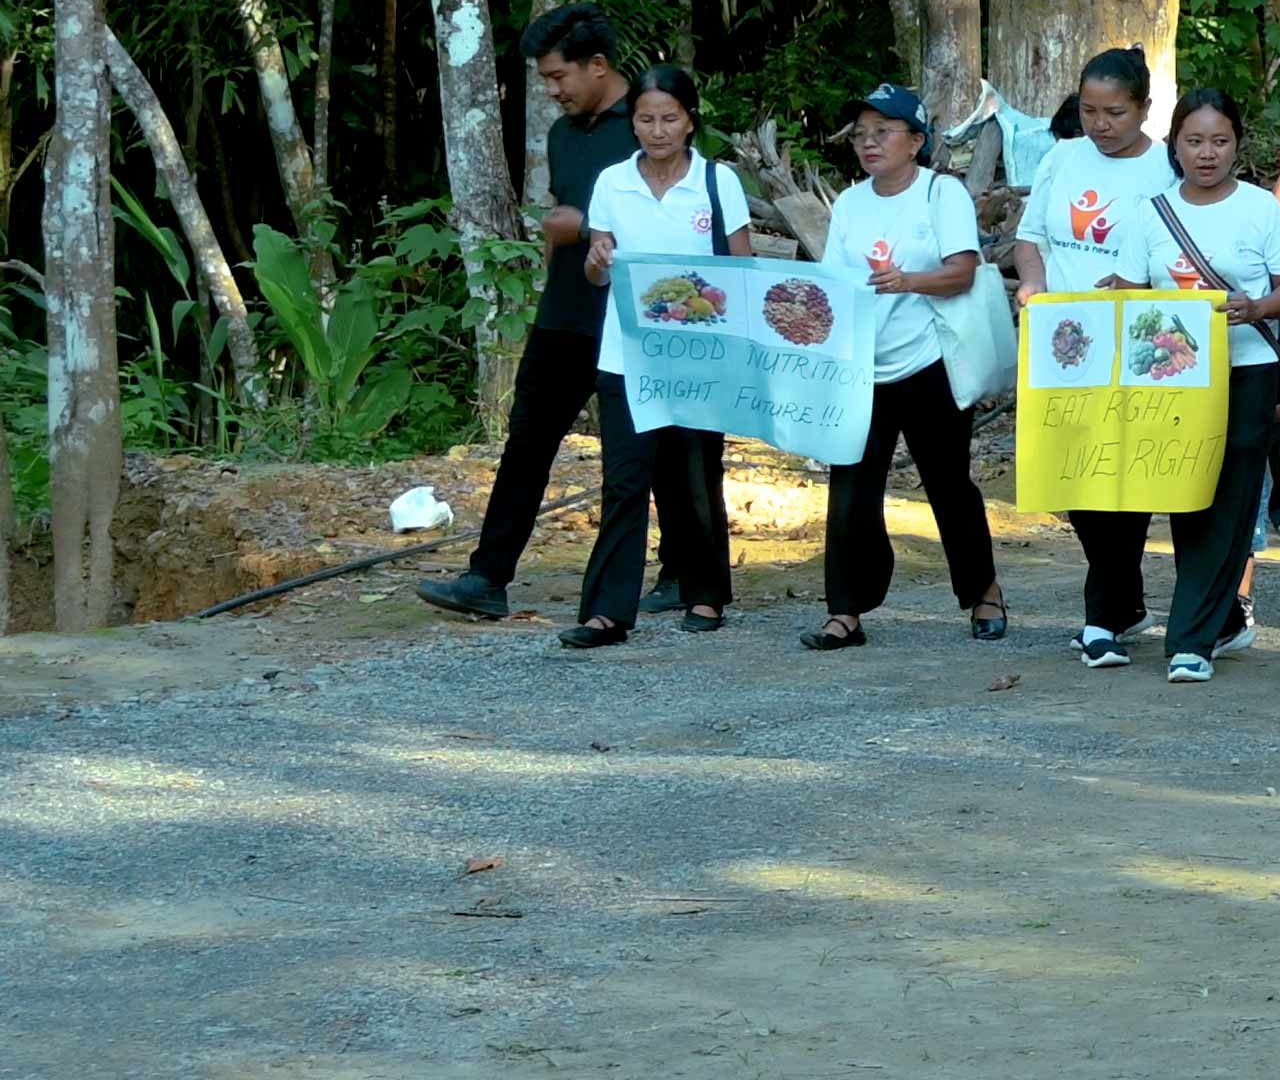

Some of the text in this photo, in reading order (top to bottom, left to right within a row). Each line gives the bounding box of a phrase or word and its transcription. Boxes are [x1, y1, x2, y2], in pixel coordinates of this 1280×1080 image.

[642, 332, 726, 360] GOOD
[637, 375, 720, 405] BRIGHT
[1043, 393, 1094, 428] EAT
[1060, 432, 1225, 480] LIVE RIGHT
